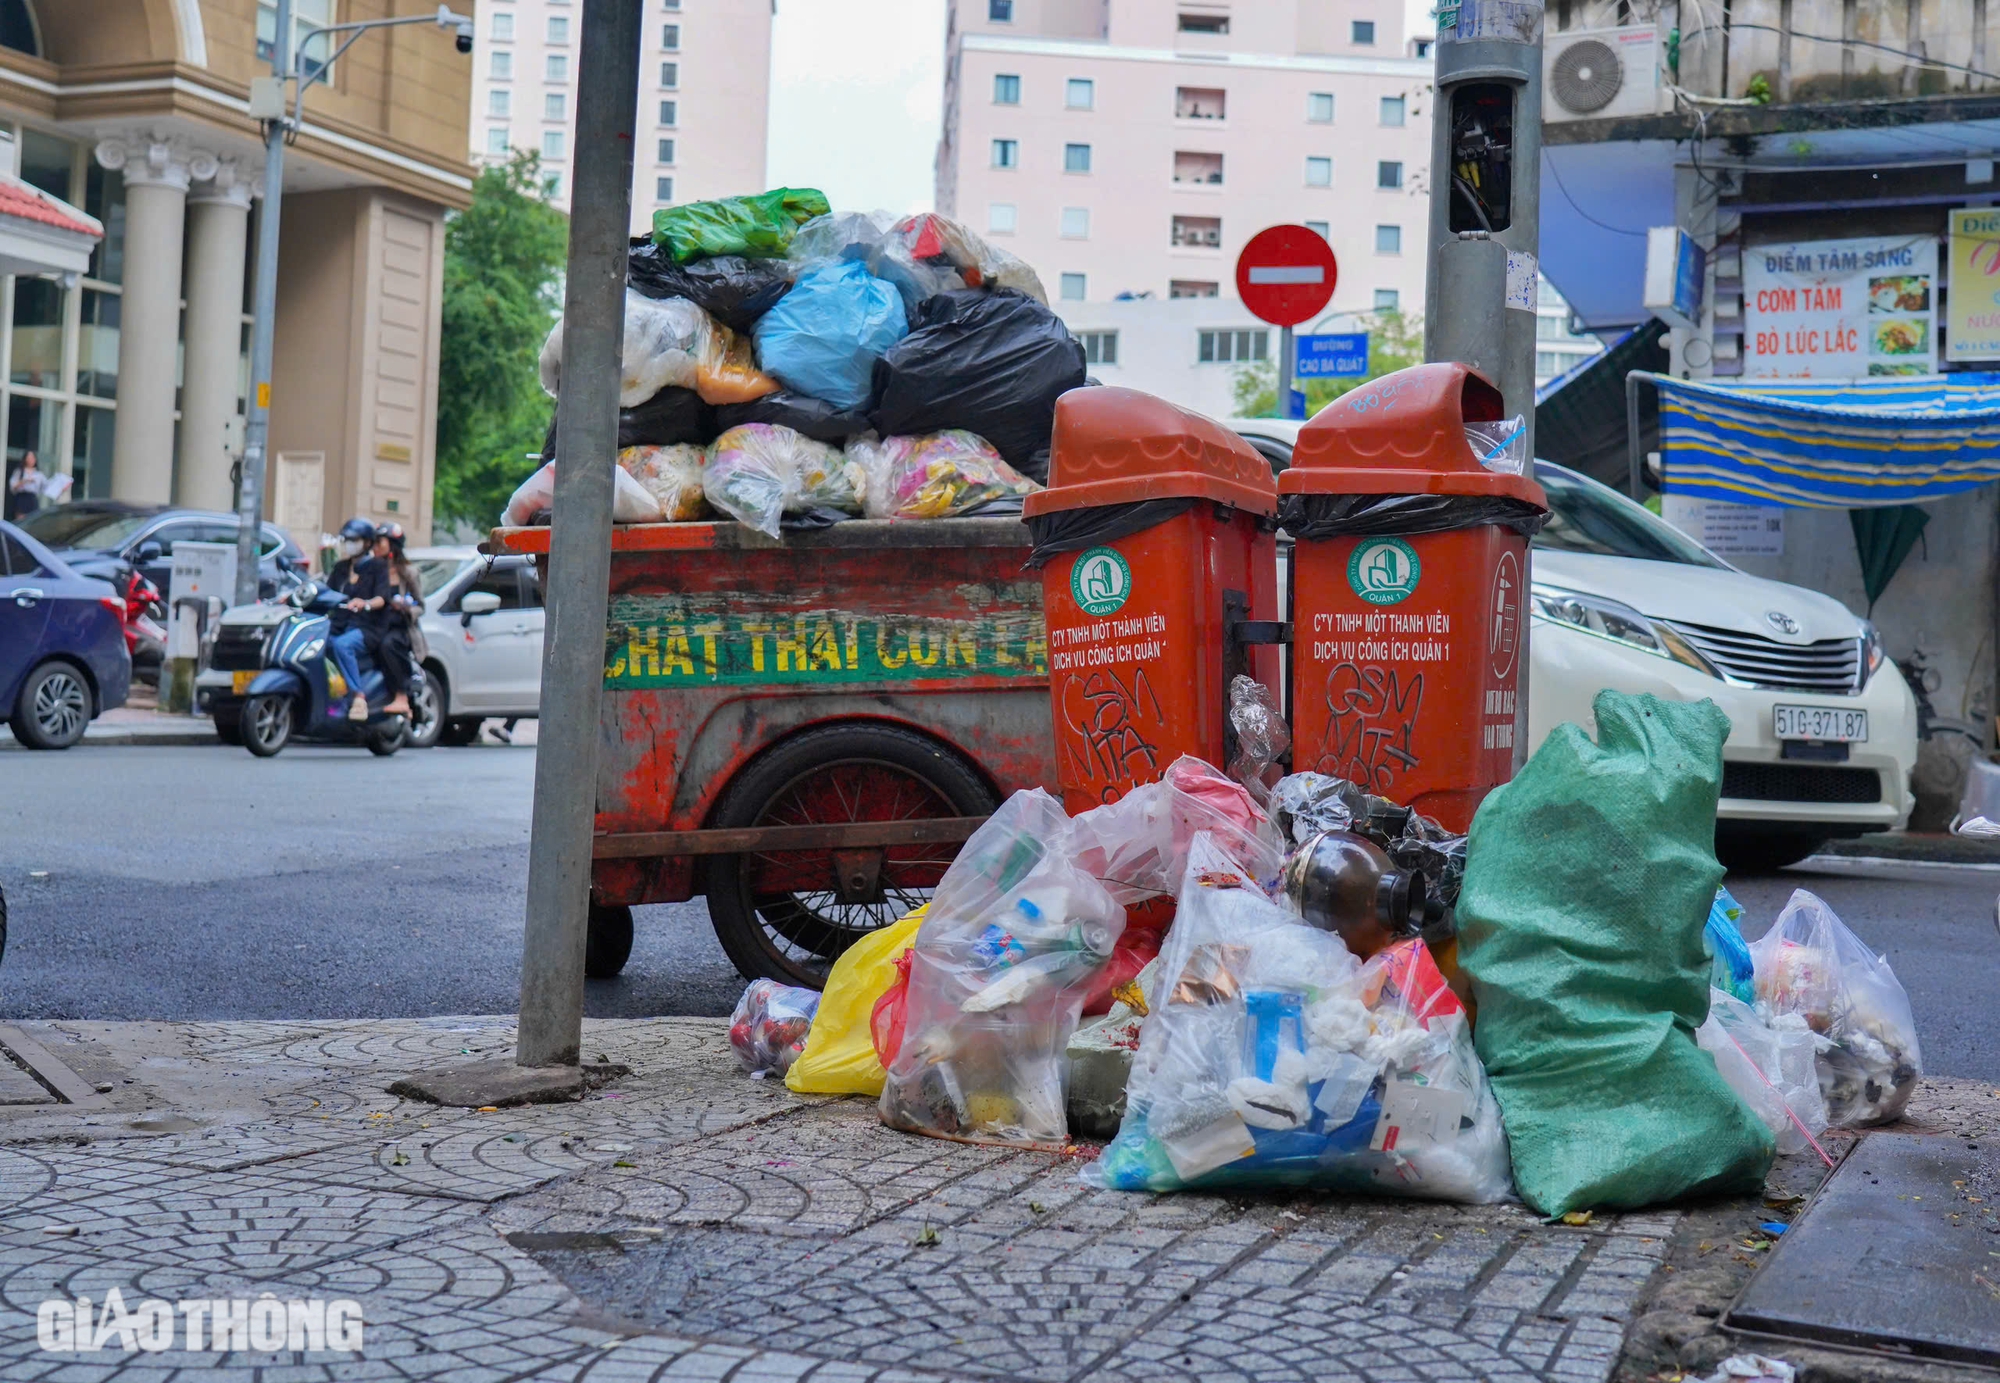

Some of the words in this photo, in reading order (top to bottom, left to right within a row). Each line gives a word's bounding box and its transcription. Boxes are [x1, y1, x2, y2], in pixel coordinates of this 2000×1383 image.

[1766, 246, 1811, 273] ĐIỂM
[1817, 248, 1857, 271] TÂM
[1863, 244, 1913, 268] SÁNG
[1757, 287, 1796, 313] CƠM
[1756, 325, 1779, 355] BÒ
[1786, 323, 1819, 354] LÚC
[1052, 629, 1065, 647] CTY
[1067, 625, 1090, 645] TNHH
[1092, 618, 1110, 643] MỘT
[1112, 615, 1143, 638] THÀNH
[1144, 611, 1166, 633] VIÊN
[1313, 614, 1333, 632] CTY
[1335, 614, 1363, 632] TNHH
[1365, 609, 1387, 637] MỘT
[1426, 609, 1450, 633] VIÊN
[1087, 643, 1114, 666] CÔNG
[1116, 641, 1132, 662] ÍCH
[1134, 637, 1161, 662] QUẬN
[1314, 641, 1338, 663] DỊCH
[1341, 641, 1355, 664] VỤ
[1358, 636, 1388, 660] CÔNG
[1391, 637, 1409, 660] ÍCH
[1444, 642, 1450, 661] 1
[1503, 684, 1515, 715] RÁC
[1777, 709, 1863, 737] 51G-371.87
